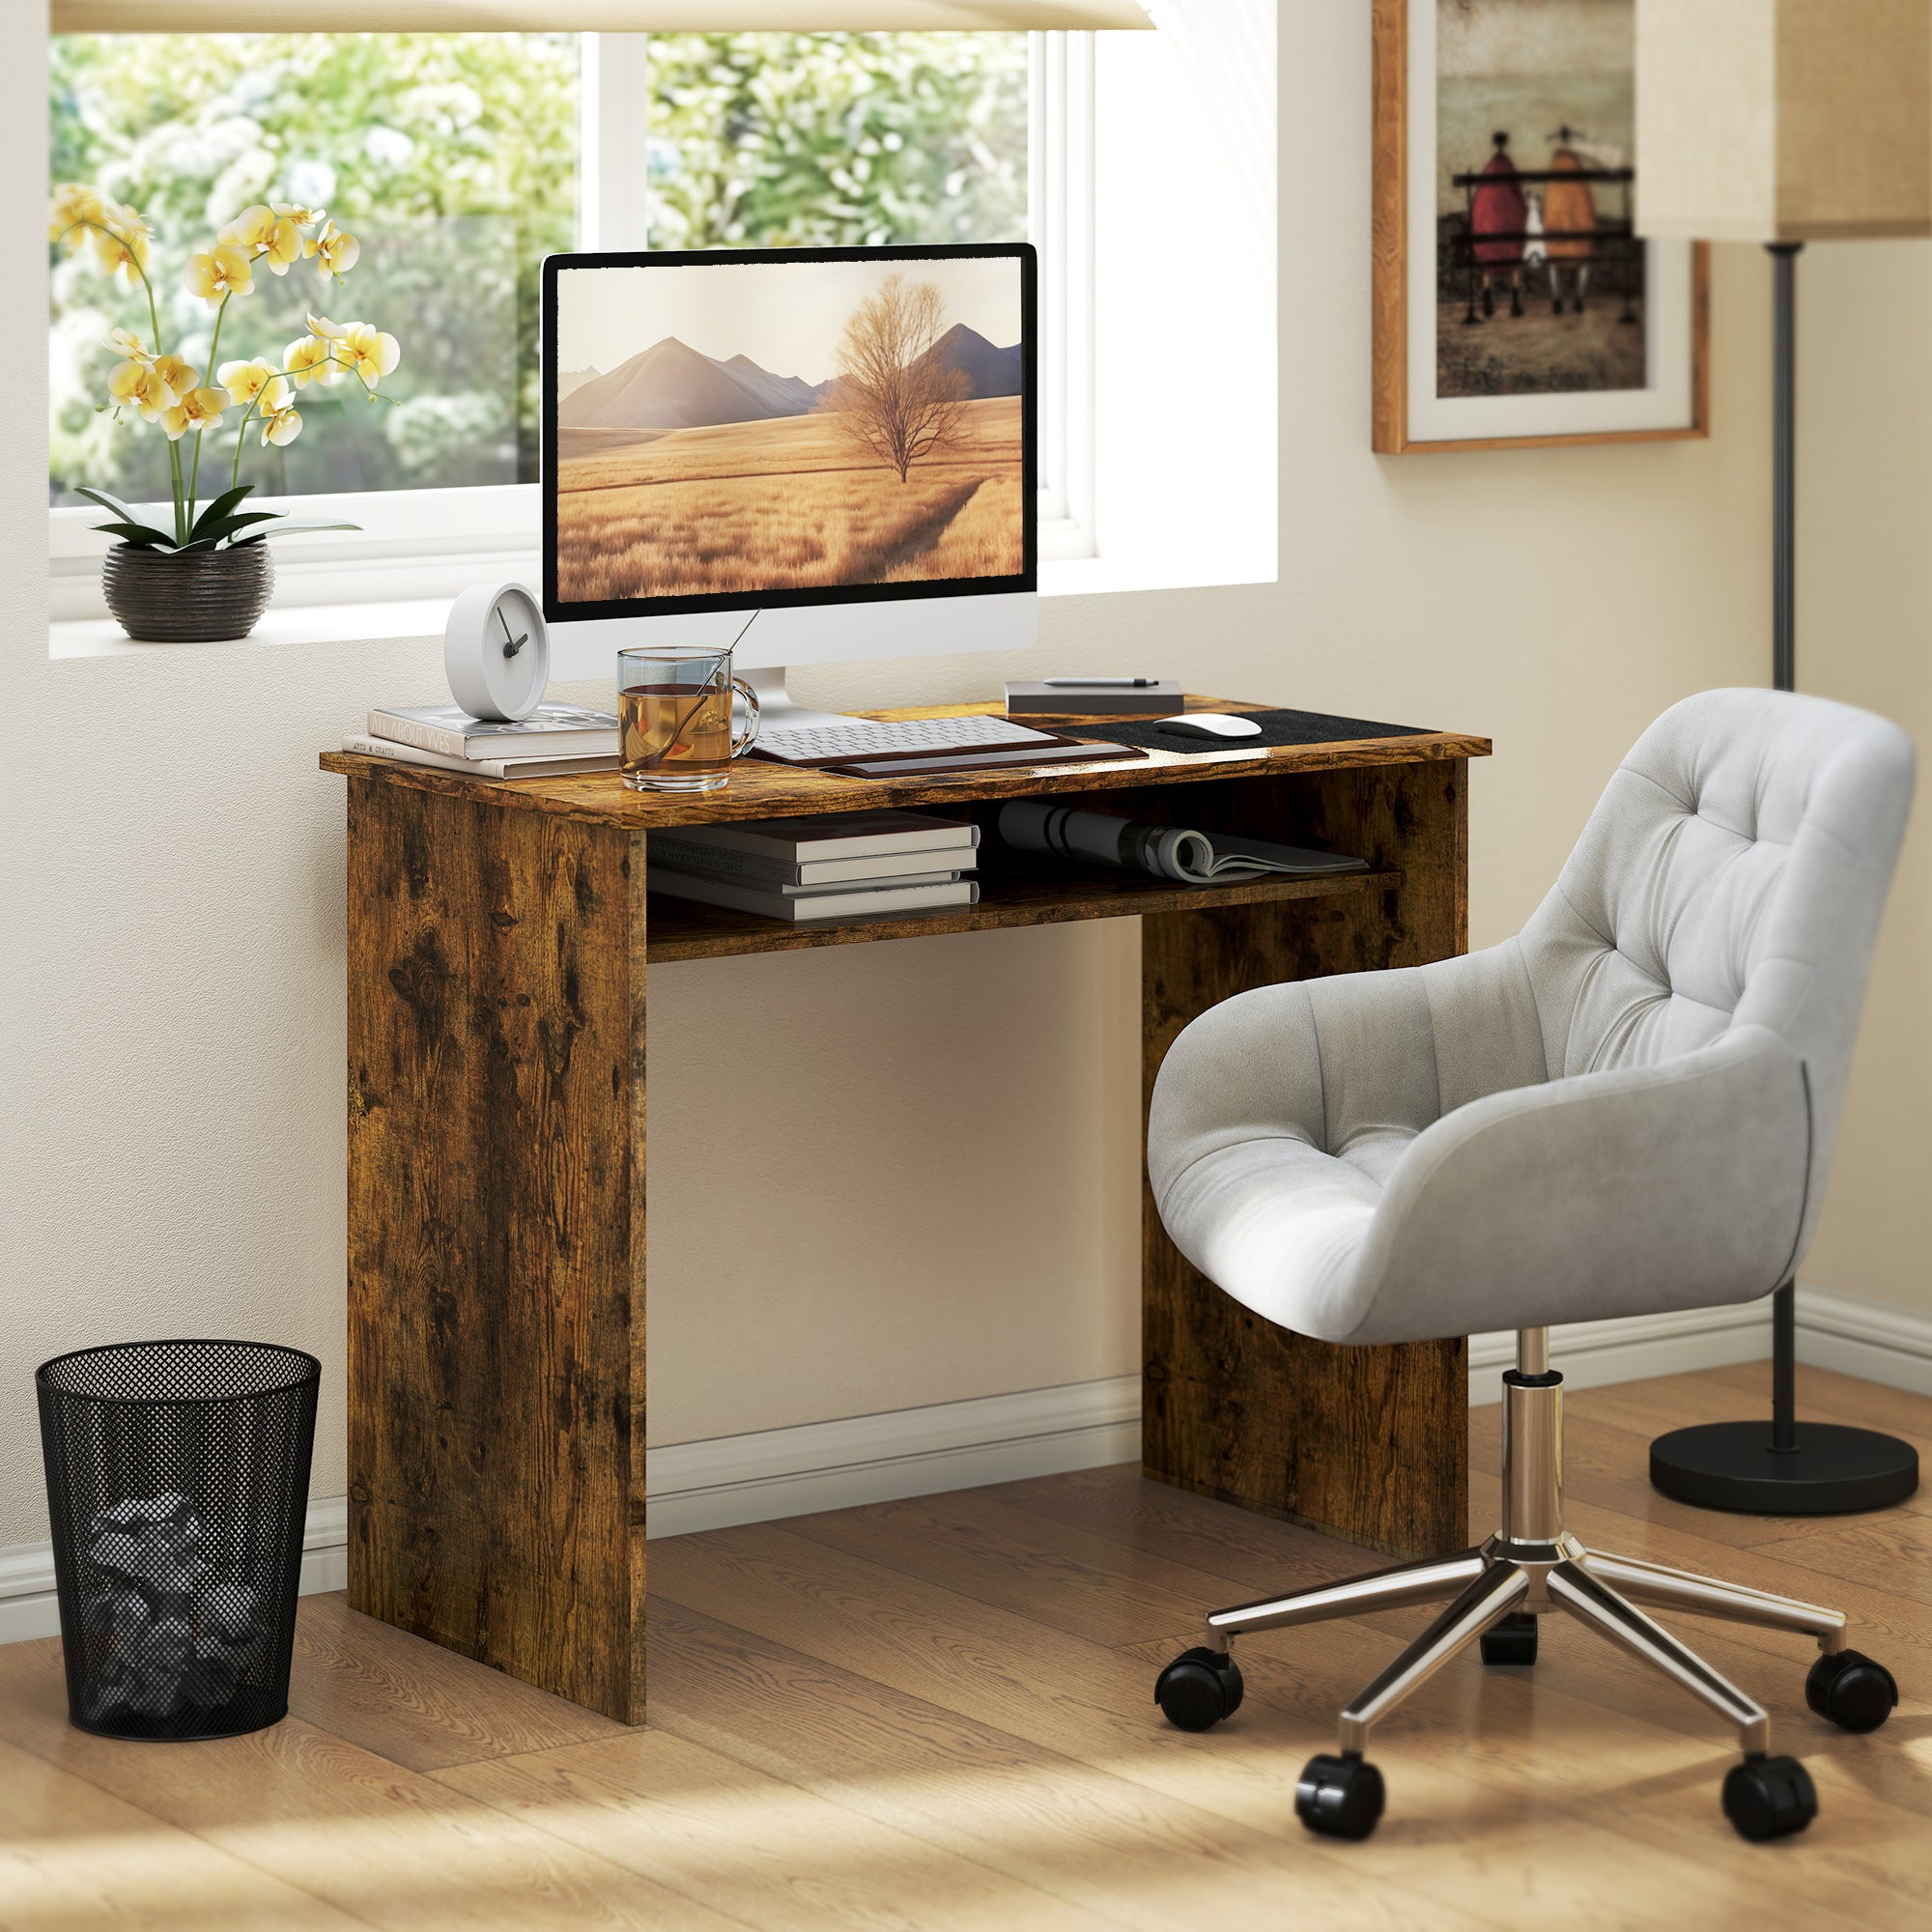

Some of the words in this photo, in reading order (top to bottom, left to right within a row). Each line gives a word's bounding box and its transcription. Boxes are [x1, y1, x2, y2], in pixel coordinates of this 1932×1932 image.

[371, 715, 388, 737] ALL
[390, 721, 423, 746] ABOUT
[426, 729, 450, 753] YVES
